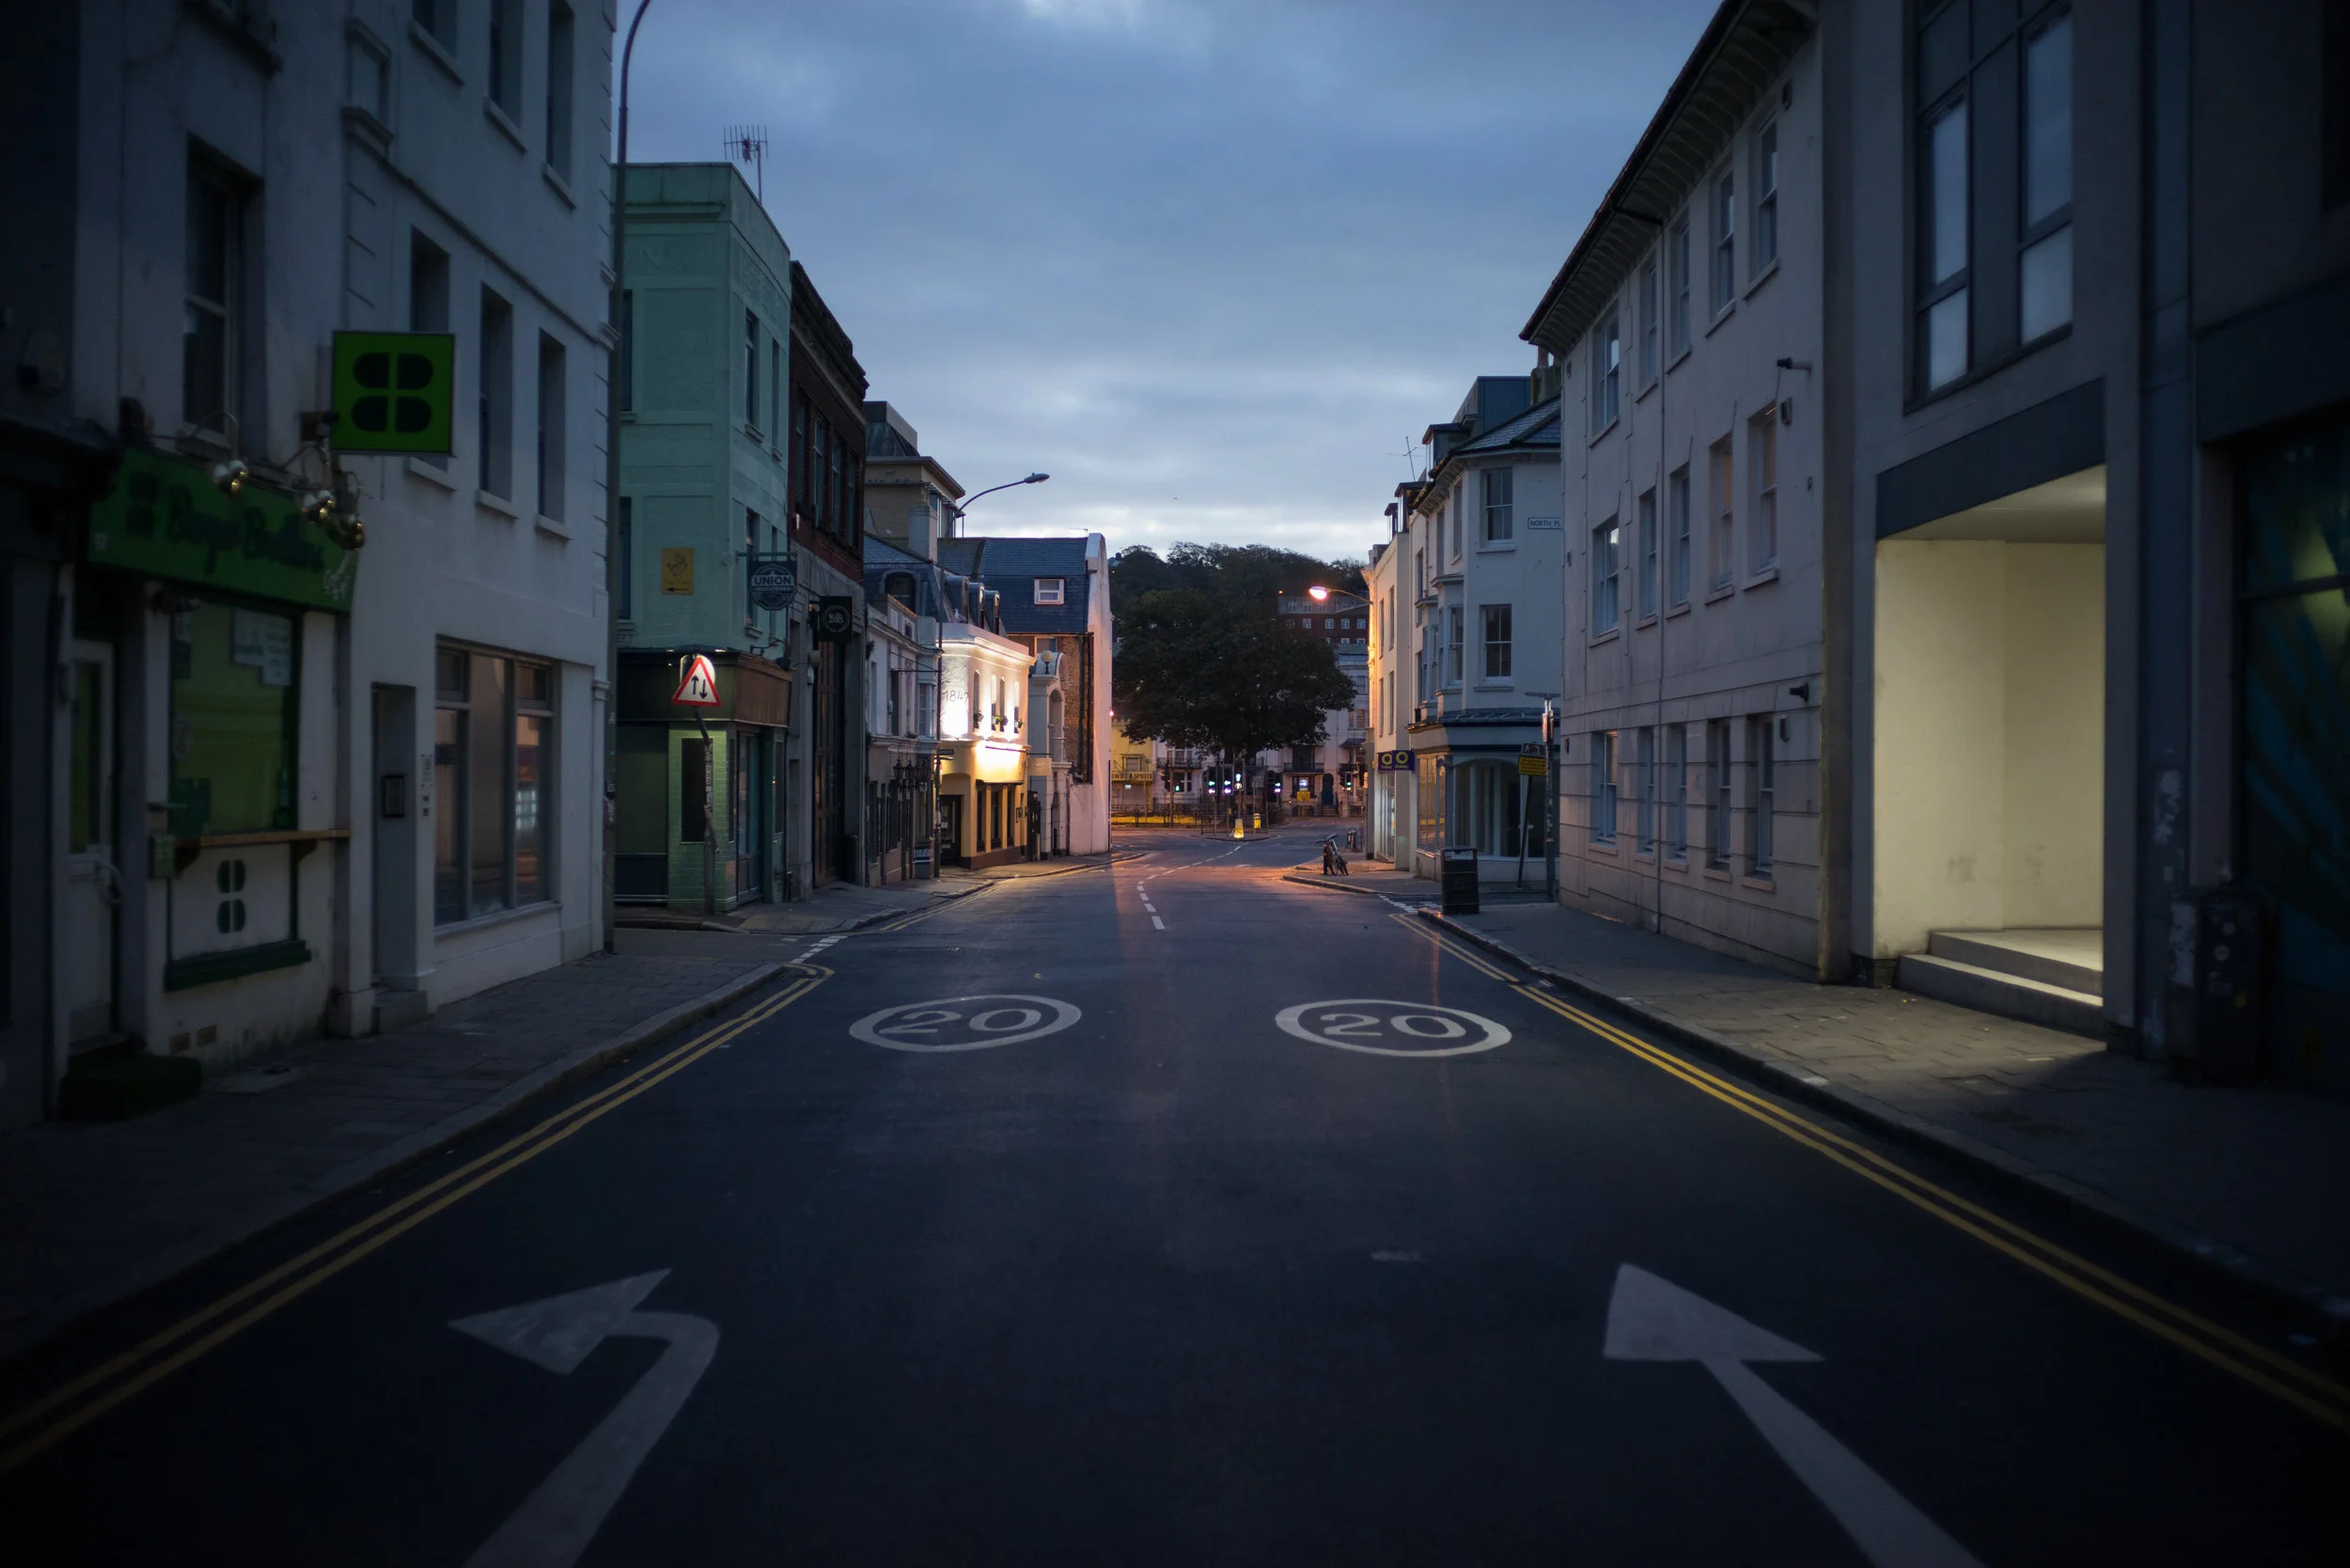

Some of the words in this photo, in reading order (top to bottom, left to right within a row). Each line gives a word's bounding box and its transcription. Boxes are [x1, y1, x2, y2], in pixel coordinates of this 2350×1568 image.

[754, 575, 791, 586] UNION
[943, 689, 969, 704] 1847
[878, 1011, 1042, 1034] 20
[1320, 1013, 1466, 1038] 20
